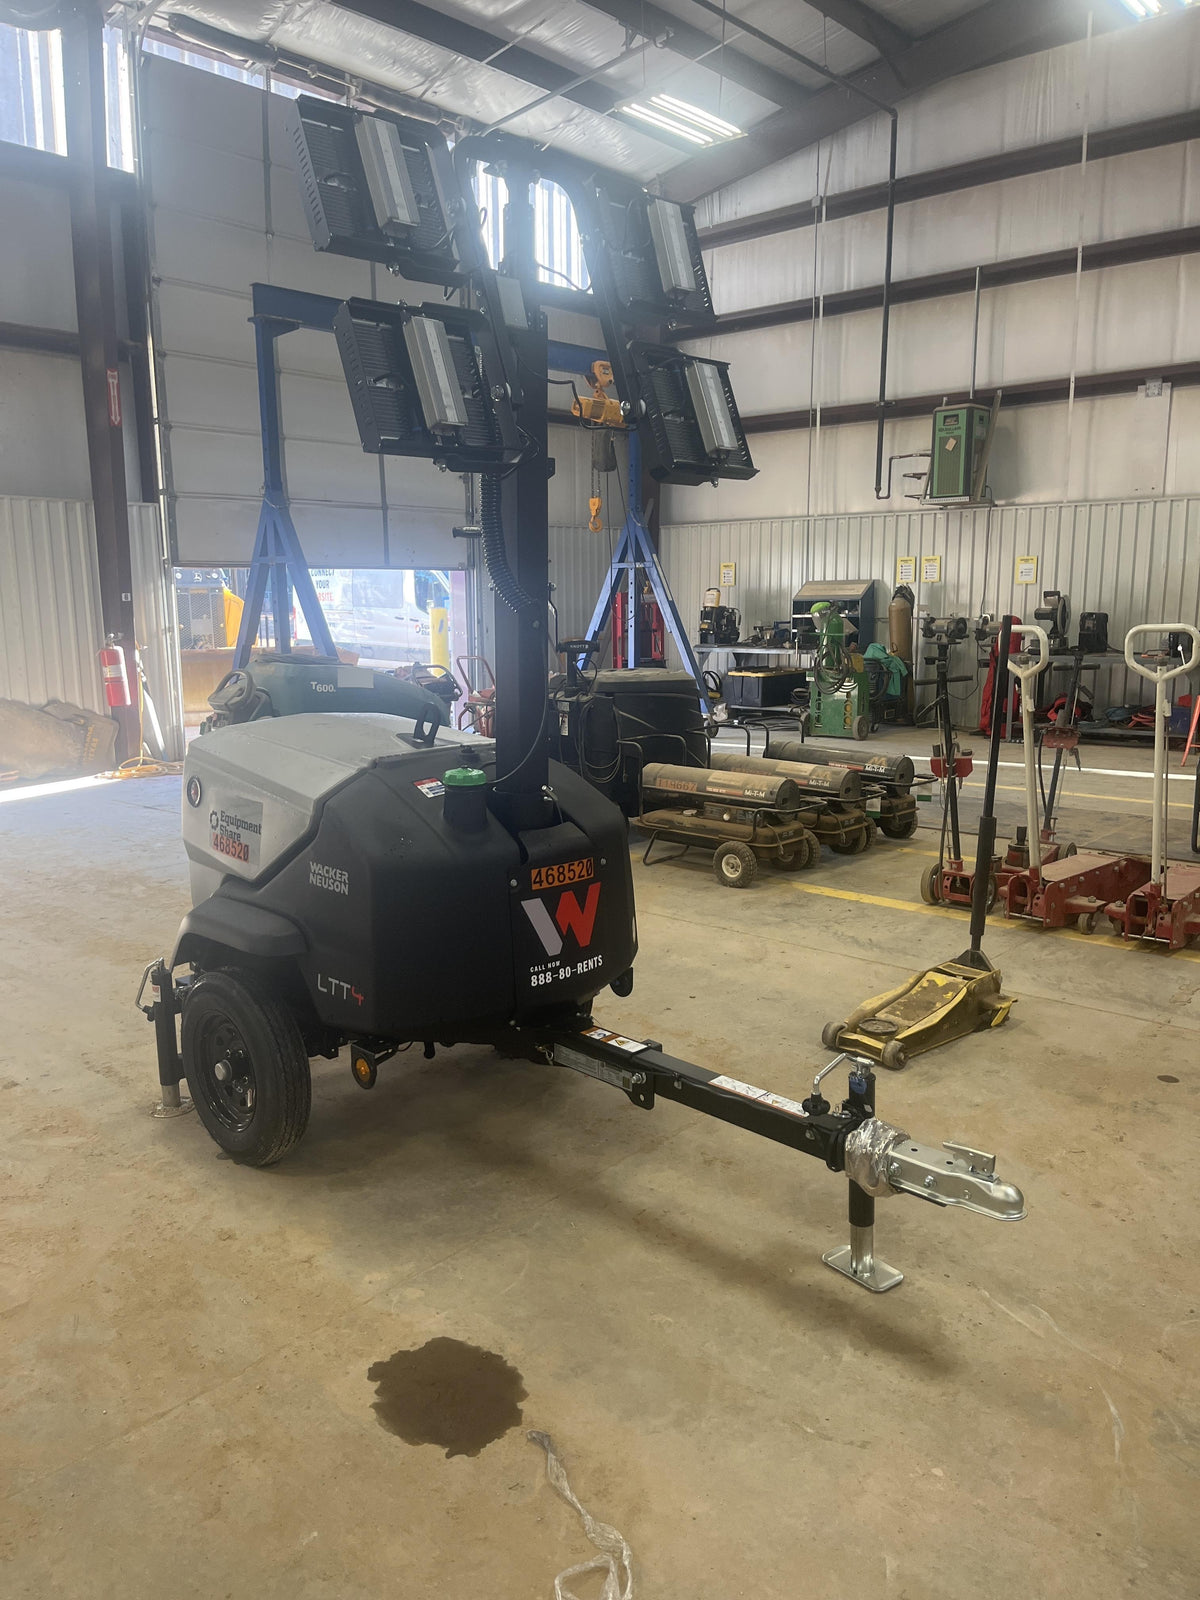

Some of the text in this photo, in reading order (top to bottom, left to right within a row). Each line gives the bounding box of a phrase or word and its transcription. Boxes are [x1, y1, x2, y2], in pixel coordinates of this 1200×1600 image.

[315, 579, 330, 589] YOUR
[864, 764, 886, 774] Mi-T-M
[744, 789, 766, 798] Mi-T-M
[808, 778, 830, 787] Mi-T-M
[219, 824, 242, 841] Share
[220, 810, 262, 835] Equipment
[213, 834, 250, 862] 468520
[309, 860, 349, 884] WACKER
[533, 858, 593, 887] 468520
[308, 873, 349, 896] NEUSON
[530, 960, 561, 973] CALL NOW
[530, 954, 604, 987] 888-80-RENTS
[317, 973, 365, 1007] LTT4
